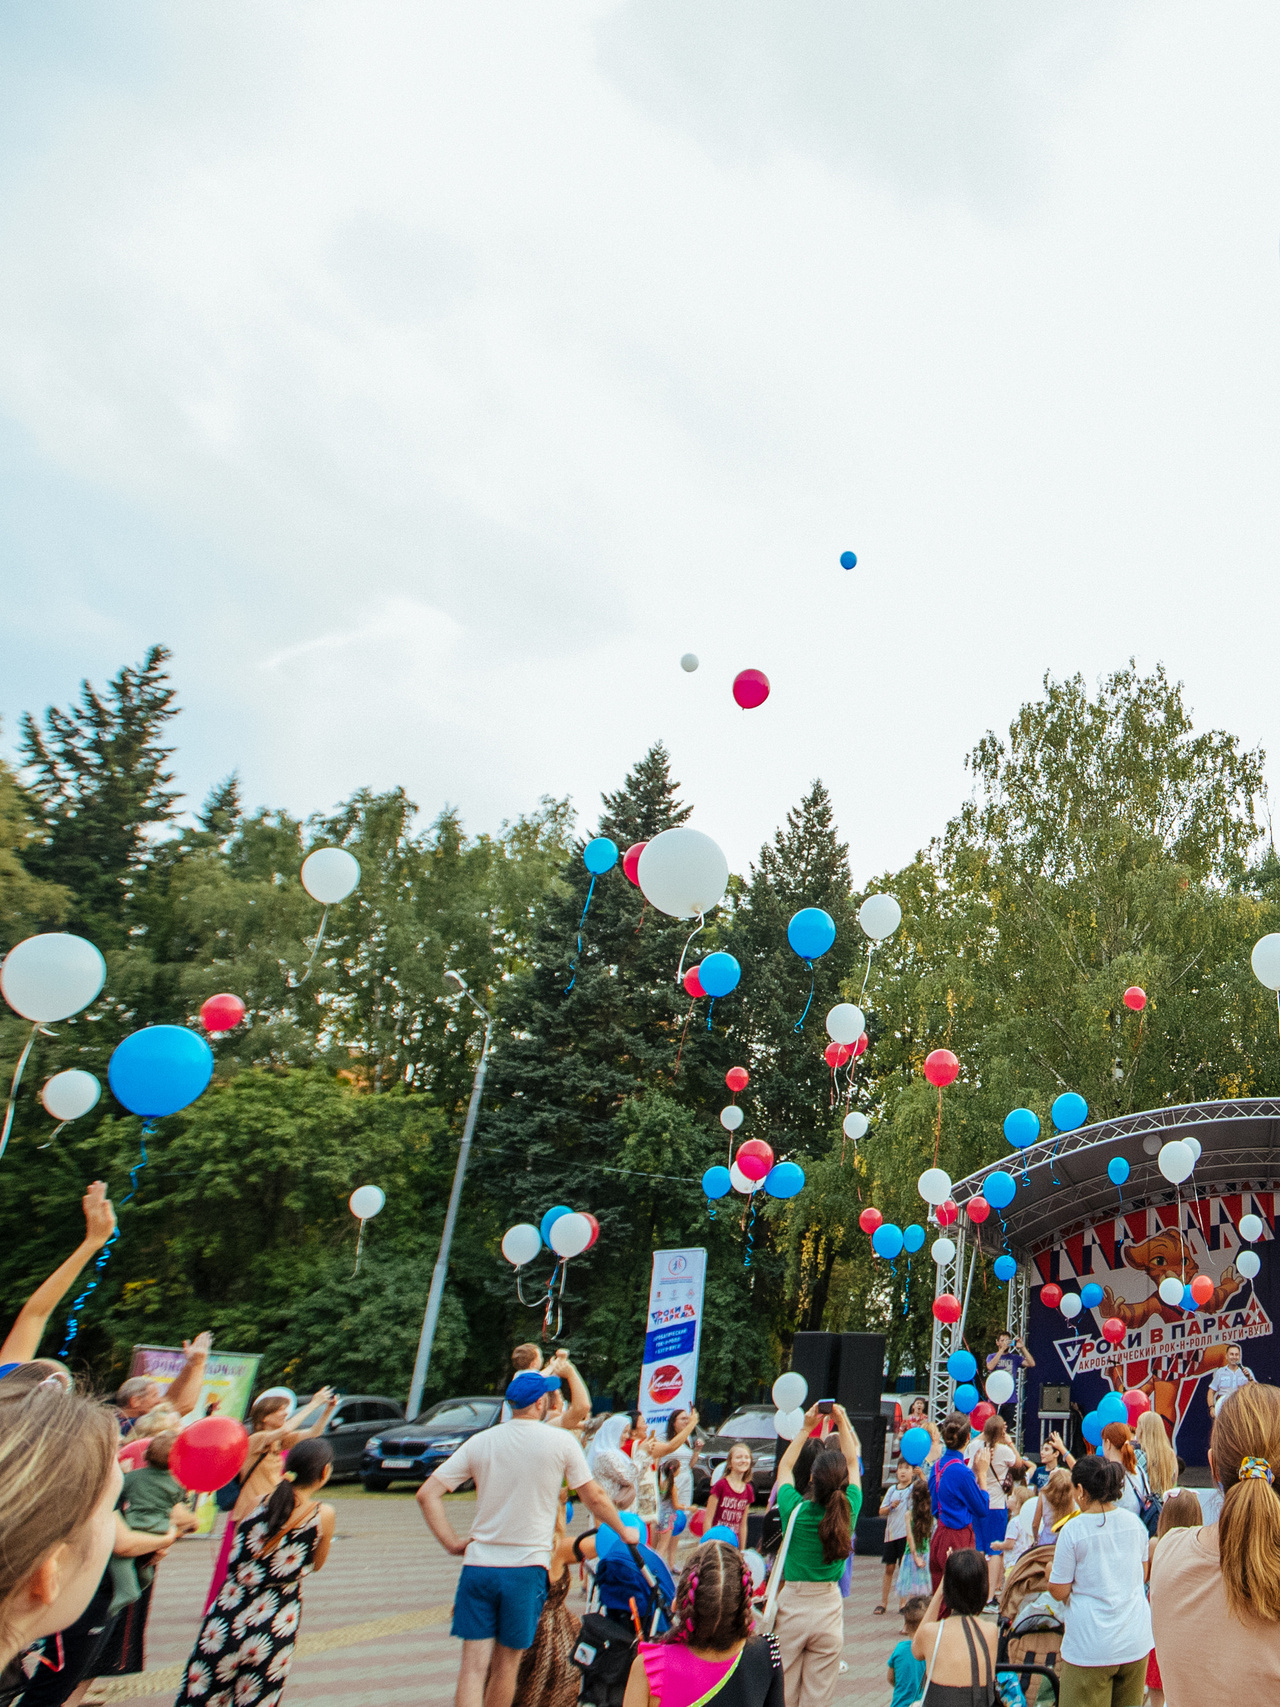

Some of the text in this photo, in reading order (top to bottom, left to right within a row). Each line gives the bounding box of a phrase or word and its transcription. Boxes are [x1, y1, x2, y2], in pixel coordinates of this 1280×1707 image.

[1065, 1308, 1267, 1362] УРОКИ В ПАРКАХ
[1078, 1344, 1158, 1371] АКРОБАТИЧЕСКИЙ
[645, 1415, 670, 1424] ХИМК
